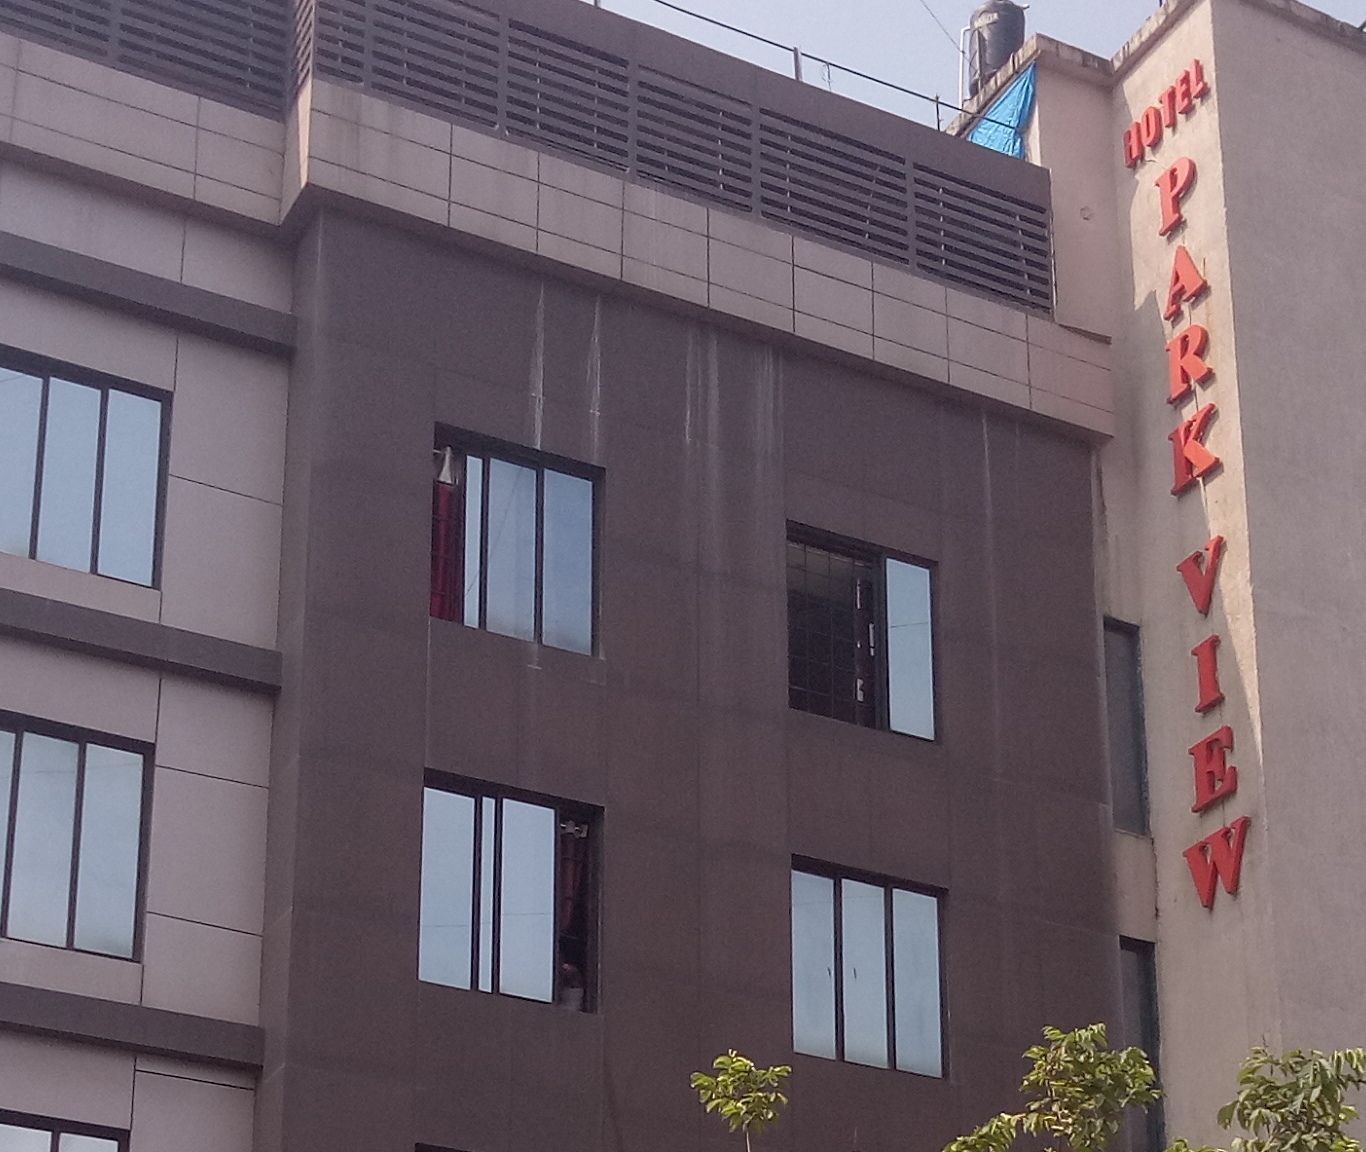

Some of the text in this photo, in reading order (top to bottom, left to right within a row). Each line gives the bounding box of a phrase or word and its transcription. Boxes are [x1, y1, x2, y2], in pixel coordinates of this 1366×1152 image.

[1123, 58, 1209, 169] HOTEL
[1154, 156, 1251, 911] PARK VIEW
